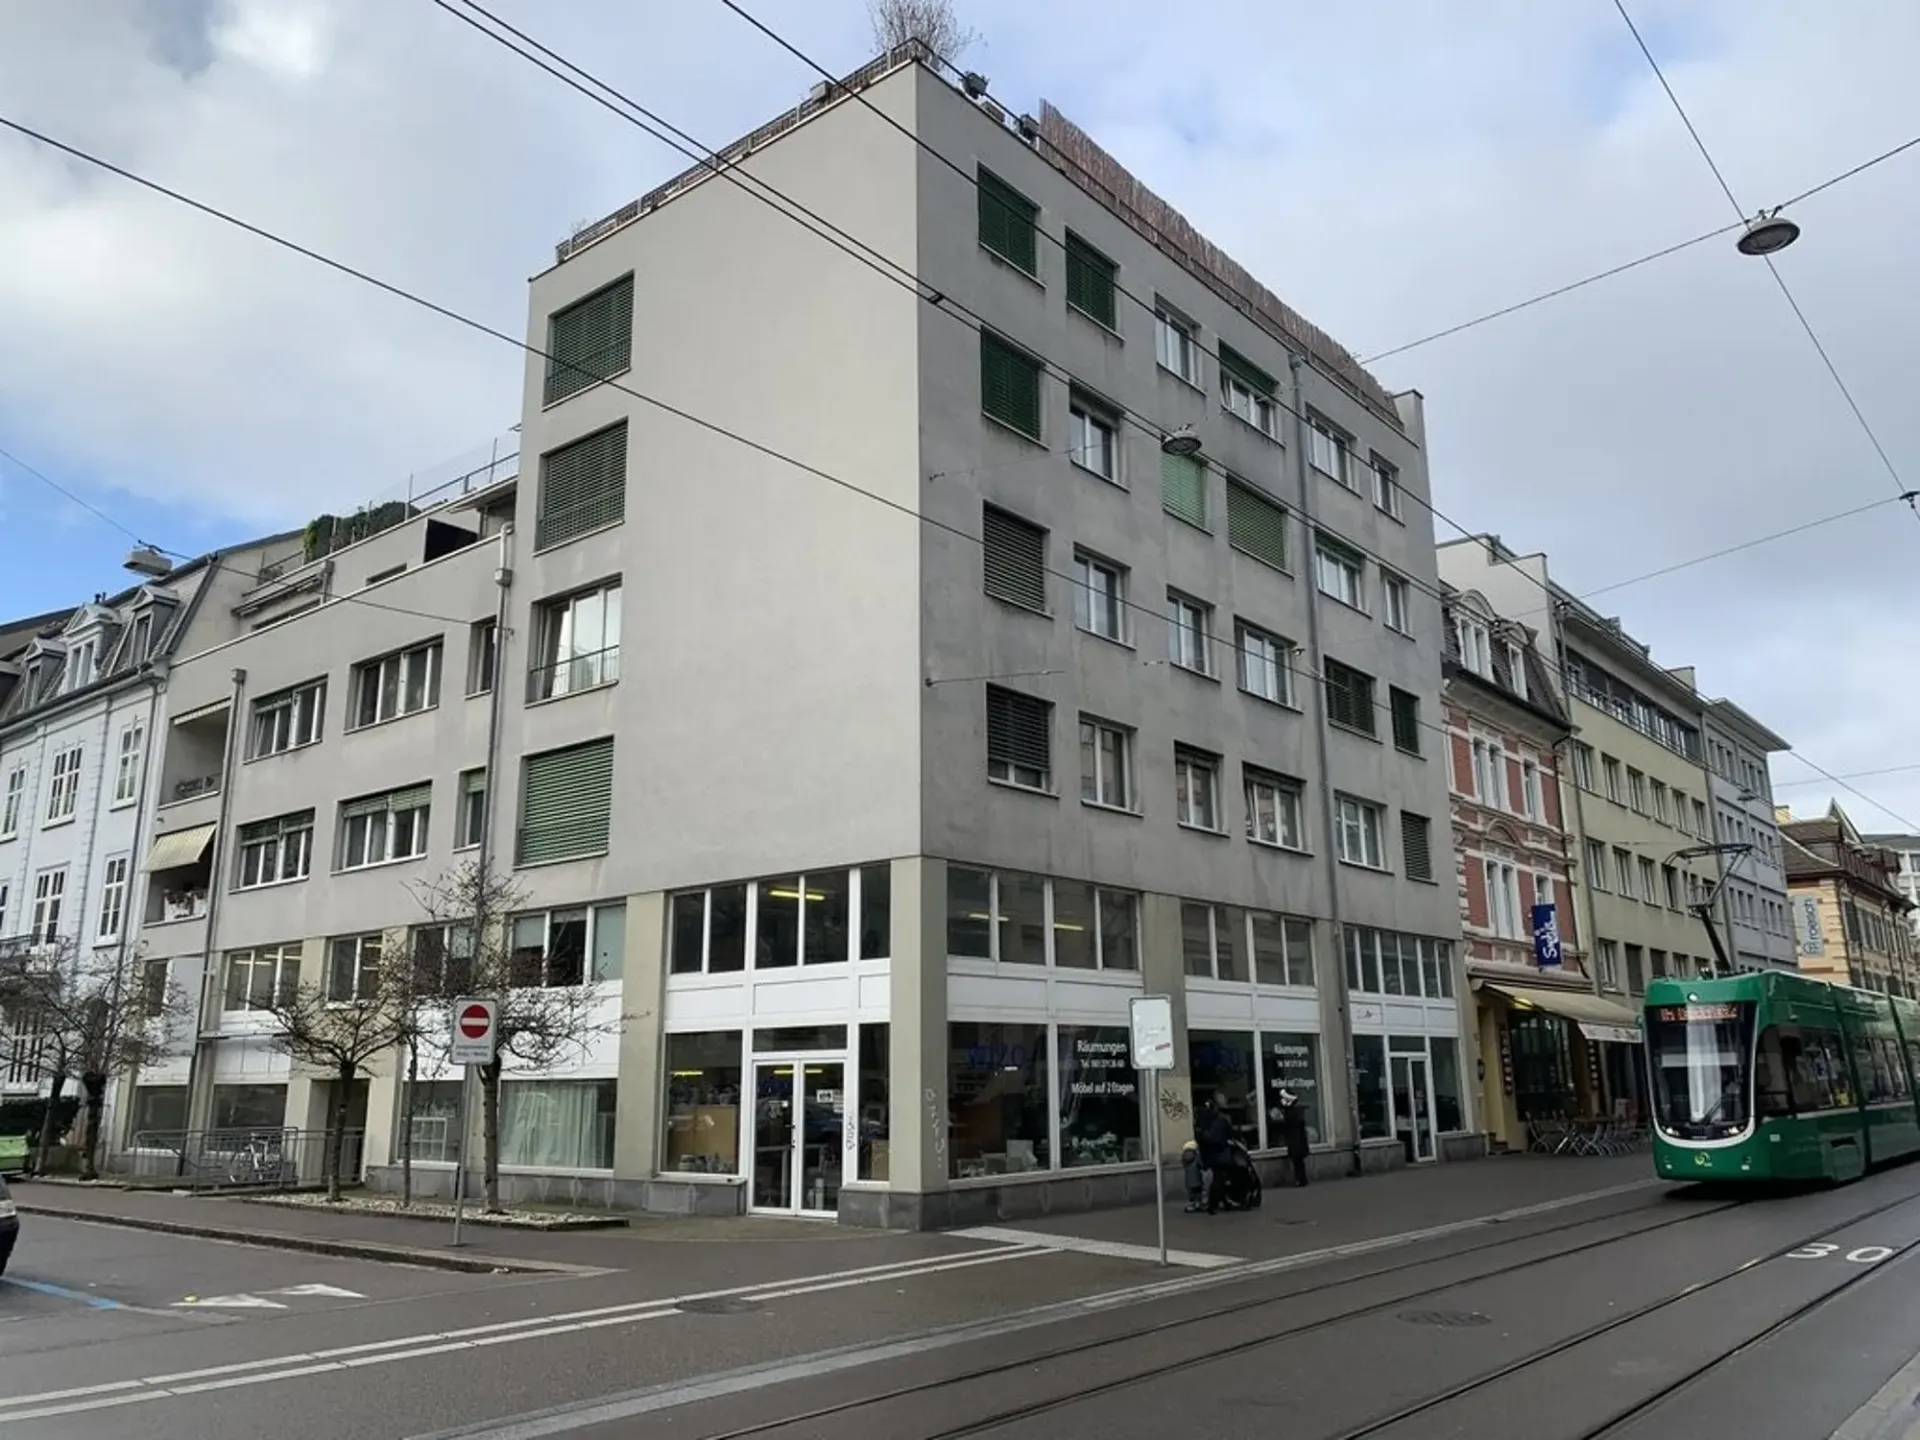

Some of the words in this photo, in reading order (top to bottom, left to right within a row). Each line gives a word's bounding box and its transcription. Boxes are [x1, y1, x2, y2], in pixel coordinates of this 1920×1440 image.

[1076, 1040, 1127, 1056] Räumungen
[1071, 1081, 1094, 1094] Möbel
[1095, 1082, 1105, 1093] auf
[1112, 1082, 1135, 1096] Etagen
[1785, 1242, 1893, 1263] 30
